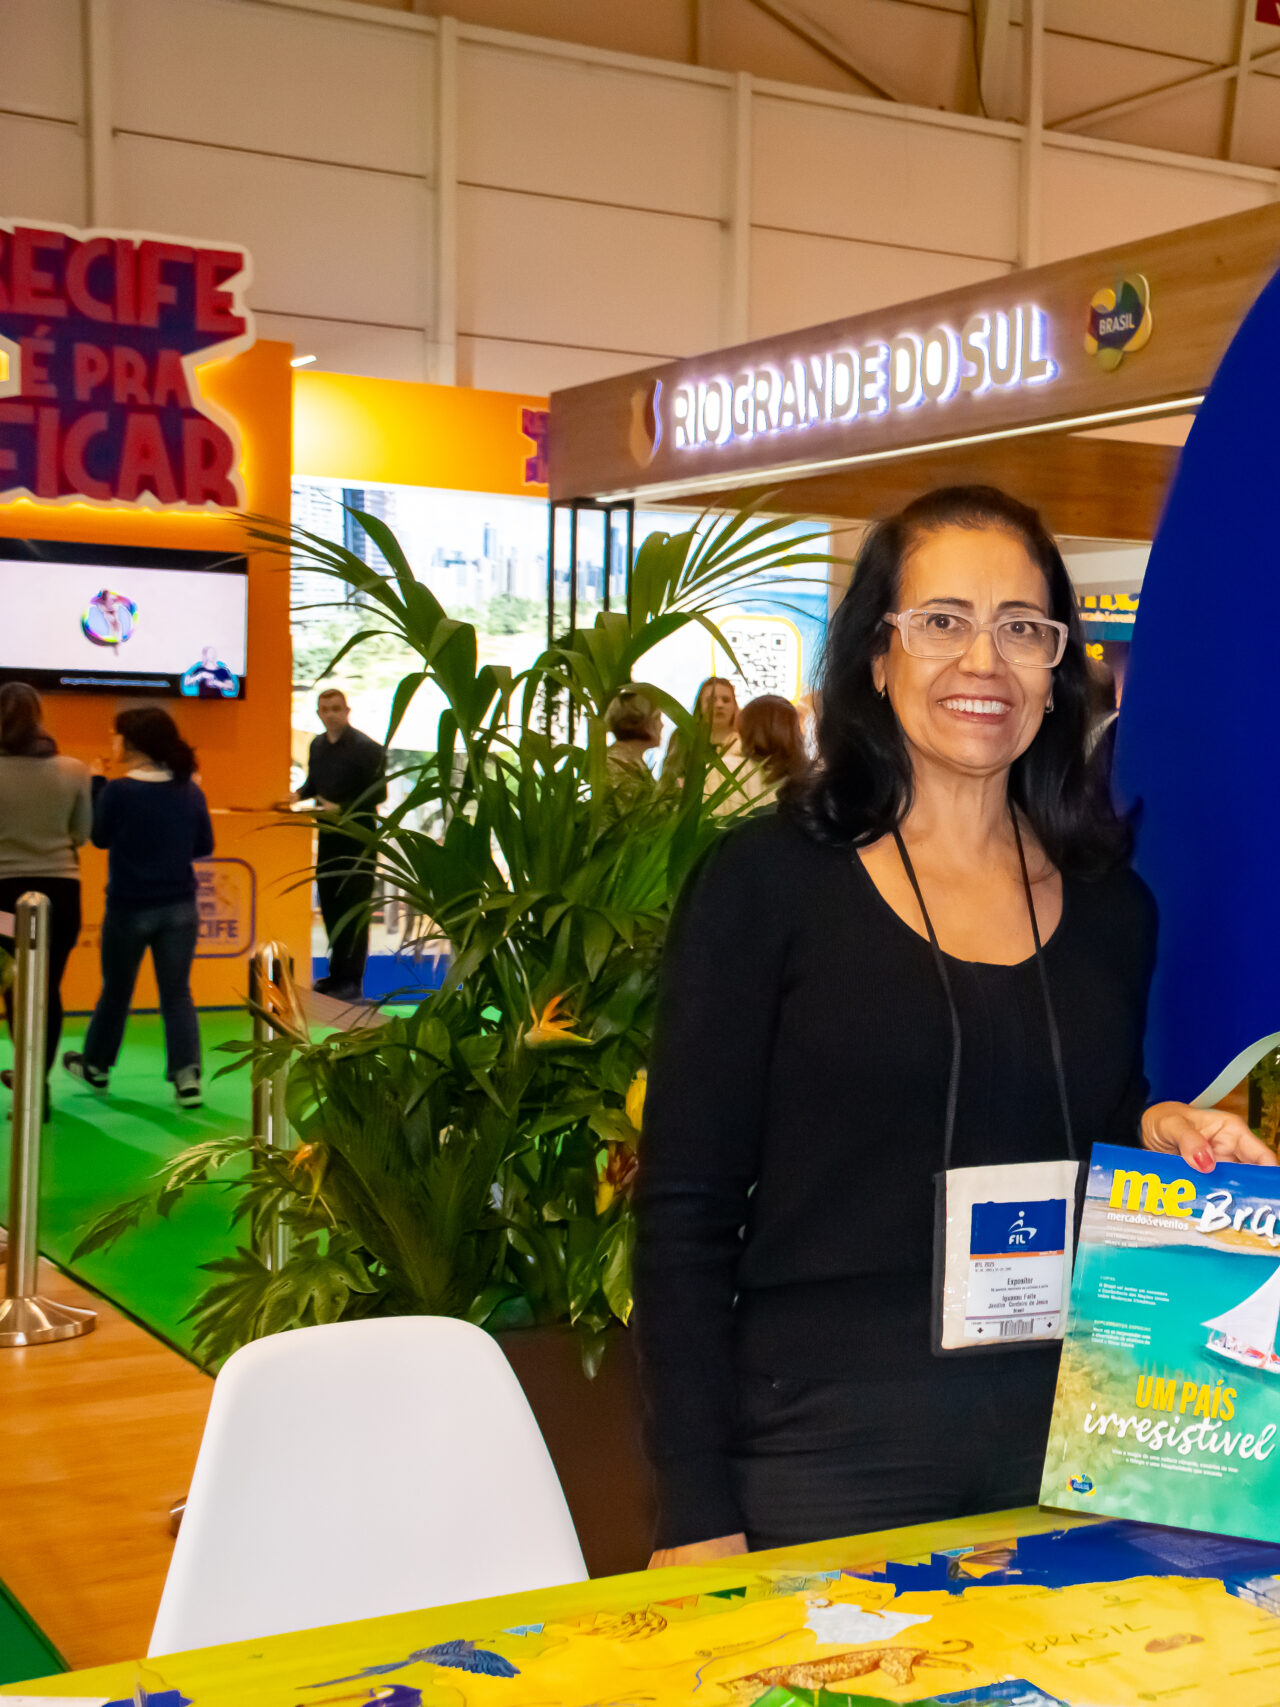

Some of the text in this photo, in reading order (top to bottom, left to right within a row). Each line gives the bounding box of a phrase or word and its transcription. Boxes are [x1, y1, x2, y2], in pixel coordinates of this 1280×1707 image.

[0, 226, 246, 336] ECIFE
[1099, 312, 1136, 335] BRASIL
[20, 325, 194, 409] É PRA
[674, 304, 1056, 449] RIO GRANDE DO SUL
[197, 919, 238, 939] CIFE
[1008, 1234, 1026, 1245] FIL
[1135, 1375, 1238, 1421] UM PAÍS
[1025, 1622, 1151, 1655] BRASIL
